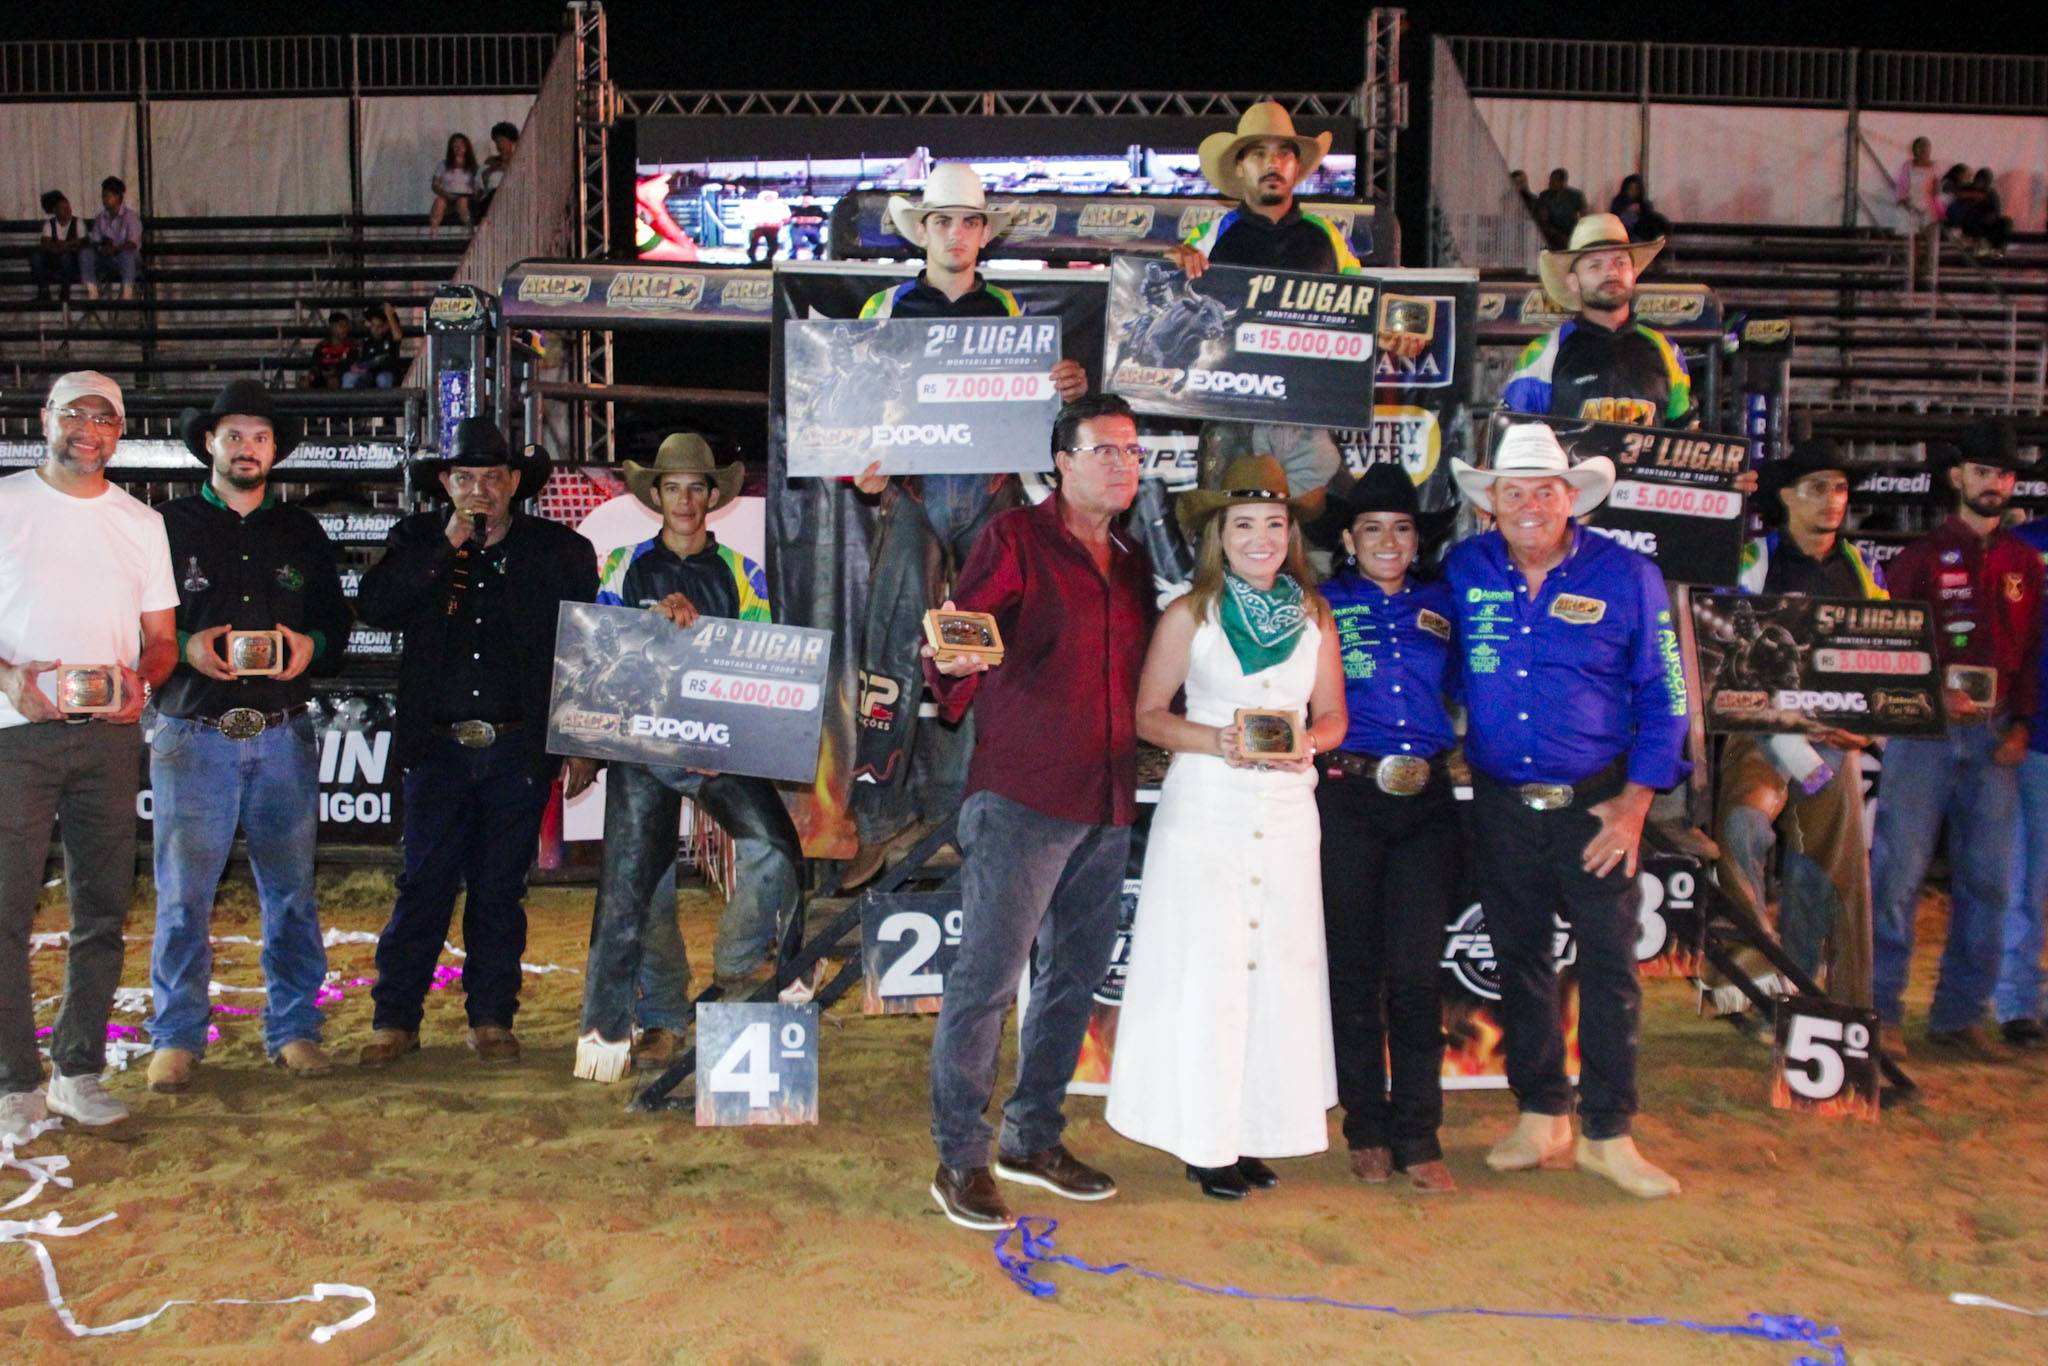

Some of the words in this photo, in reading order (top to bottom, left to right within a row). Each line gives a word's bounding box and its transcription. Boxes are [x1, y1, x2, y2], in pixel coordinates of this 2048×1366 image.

[1280, 279, 1375, 316] LUGAR
[962, 325, 1055, 355] LUGAR
[1260, 329, 1363, 359] 15.000,00
[946, 376, 1039, 400] 7.000,00
[1188, 369, 1287, 398] EXPOVG
[872, 423, 972, 446] EXPOVG
[1656, 437, 1745, 473] LUGAR
[1636, 486, 1729, 515] 5.000,00
[1848, 606, 1925, 632] LUGAR
[729, 629, 823, 665] LUGAR
[713, 658, 753, 669] MONTARIA
[709, 677, 805, 708] 4.000,00
[633, 714, 731, 745] EXPOVG
[709, 1022, 807, 1108] 4º
[1783, 1014, 1870, 1099] 5º
